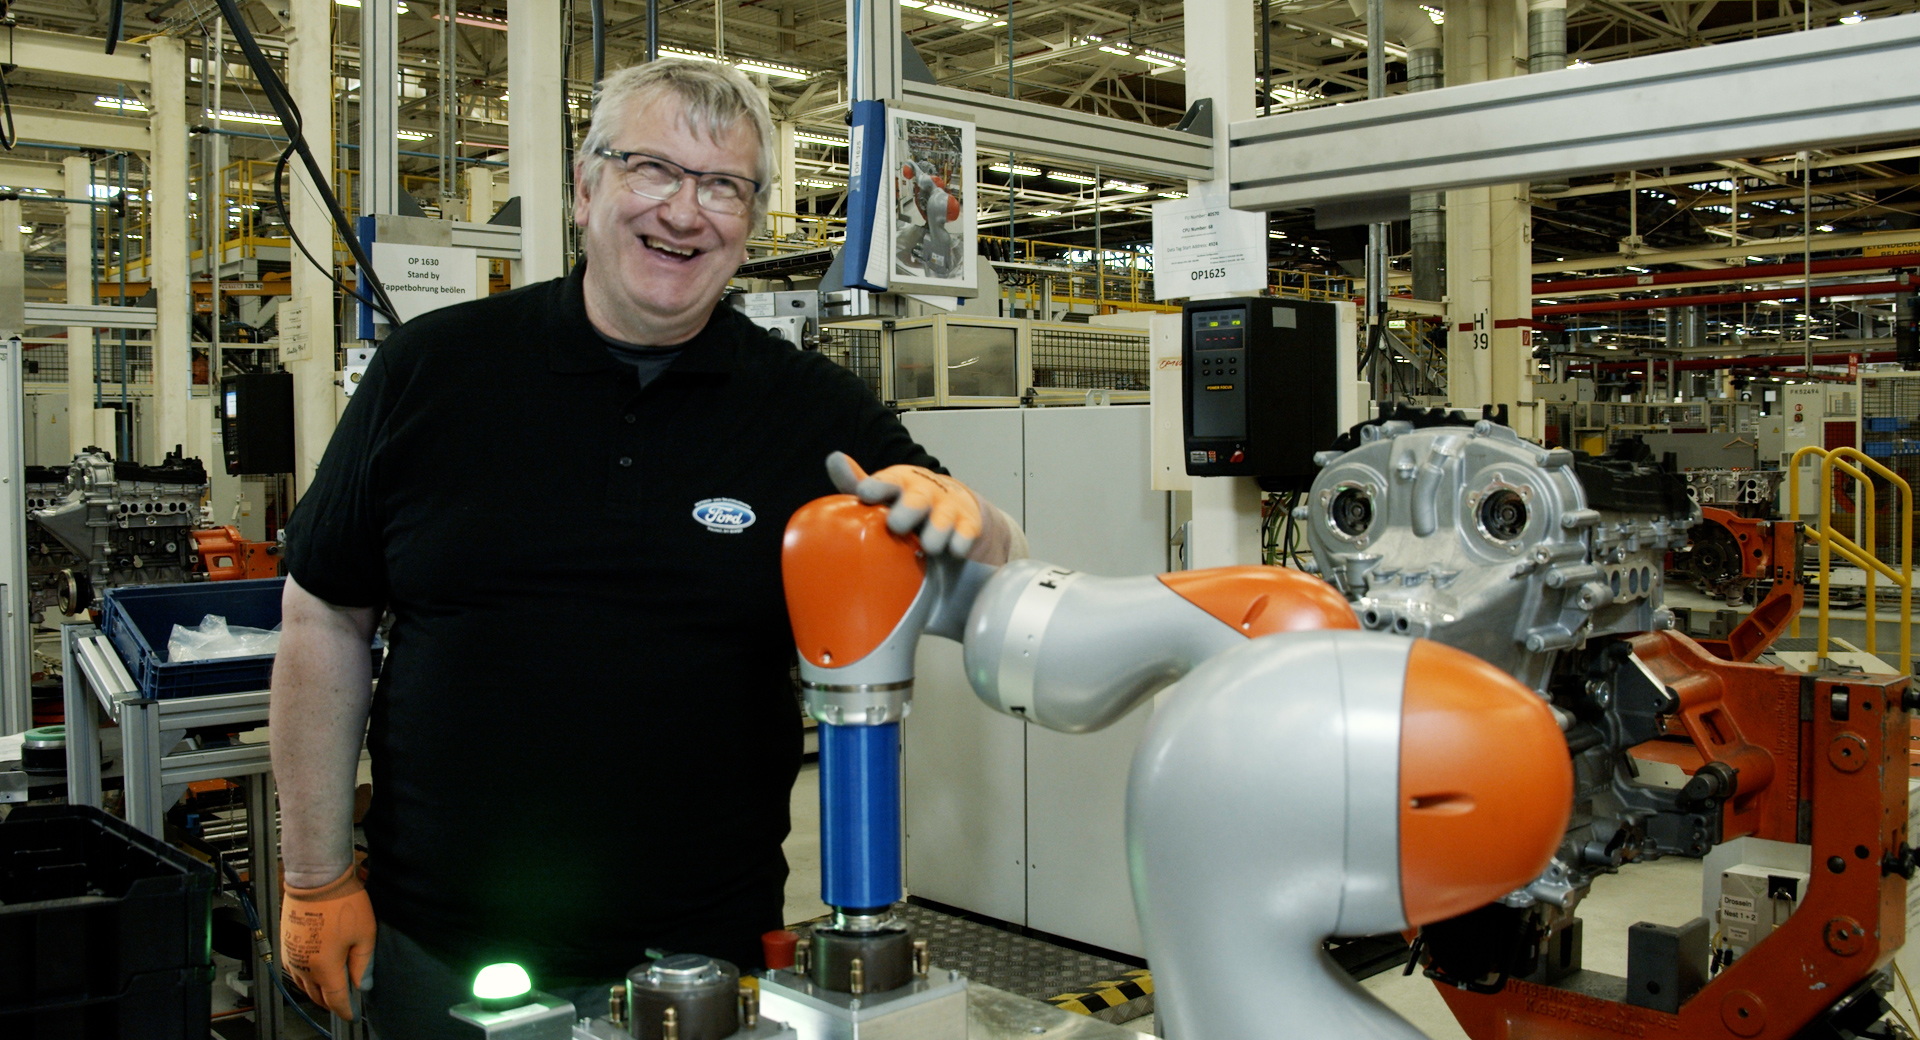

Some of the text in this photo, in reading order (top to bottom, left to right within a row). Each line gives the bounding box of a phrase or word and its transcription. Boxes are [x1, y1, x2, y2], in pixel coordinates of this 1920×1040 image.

[408, 257, 440, 266] OP 1630
[407, 270, 440, 281] Stand by
[1191, 267, 1226, 281] OP1625
[381, 282, 466, 294] Tappetbohrung beölen
[705, 505, 743, 525] Ford
[1723, 909, 1739, 919] Nest
